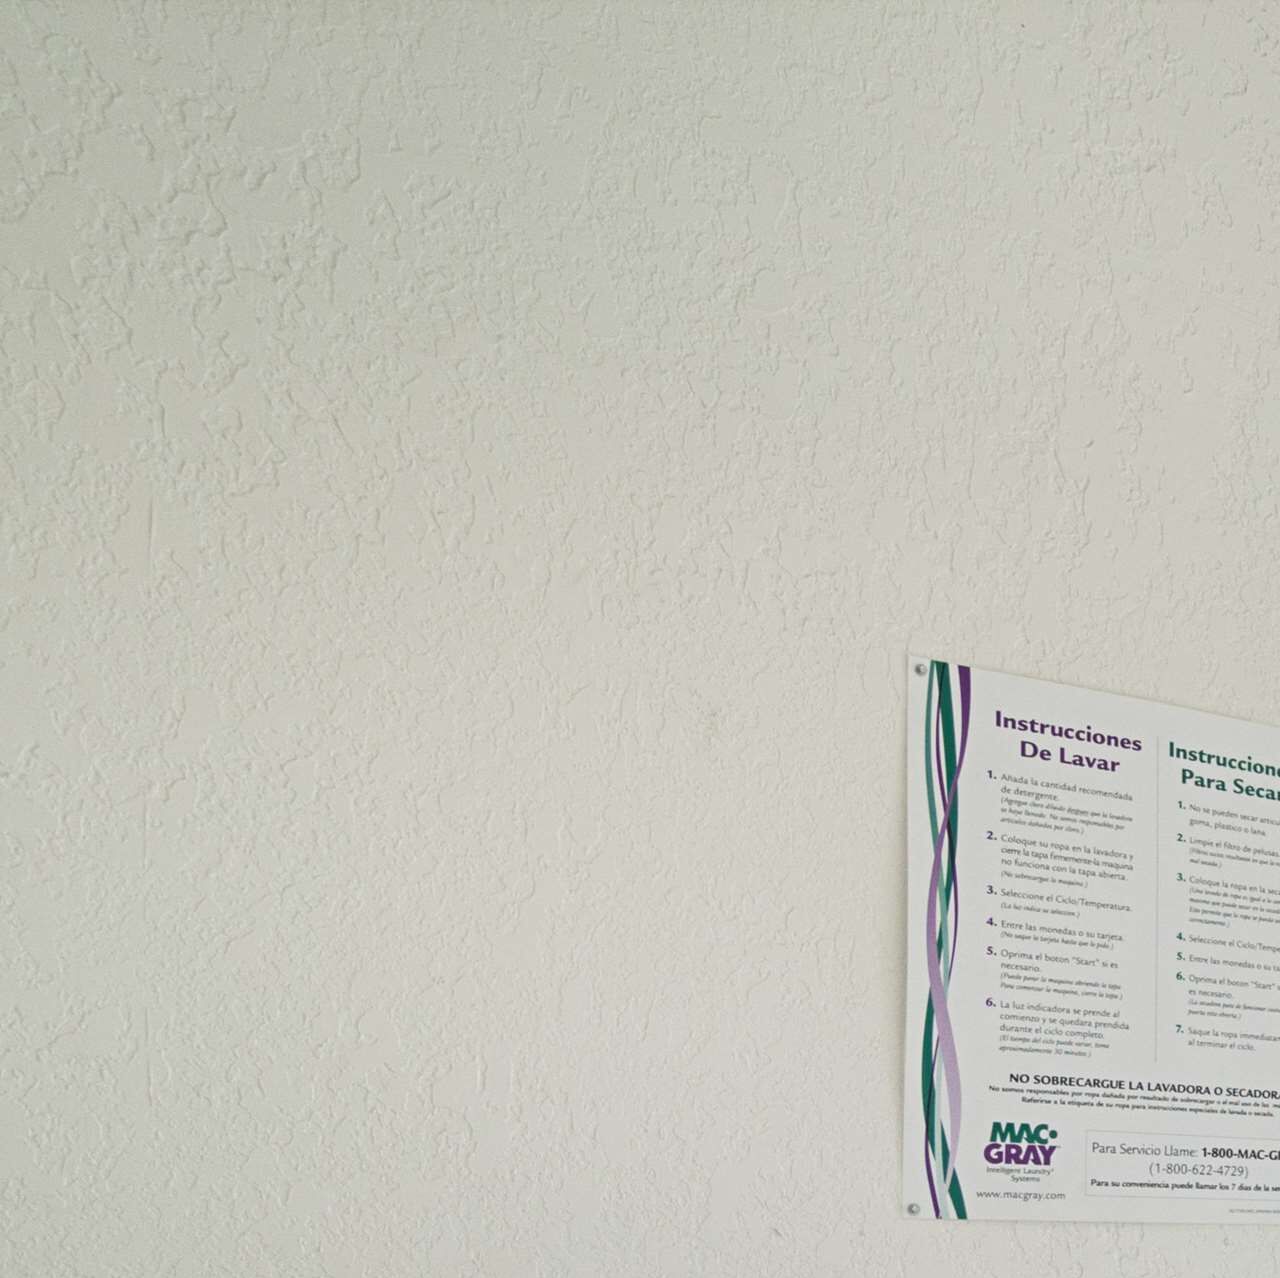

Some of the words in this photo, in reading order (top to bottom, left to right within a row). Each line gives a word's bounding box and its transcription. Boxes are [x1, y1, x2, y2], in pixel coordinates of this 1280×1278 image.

[995, 710, 1142, 751] Instrucciones
[1020, 741, 1051, 761] De
[1060, 747, 1120, 772] Lavar
[1031, 778, 1038, 786] la
[1040, 780, 1076, 792] cantidad
[1079, 787, 1133, 801] recomendada
[1182, 768, 1226, 792] Para
[986, 831, 997, 840] 2.
[1001, 834, 1036, 847] Coloque
[1051, 842, 1069, 851] ropa
[1084, 846, 1091, 854] la
[1094, 846, 1127, 860] lavadora
[1001, 858, 1012, 866] no
[1015, 858, 1049, 871] funciona
[1052, 865, 1067, 873] con
[1070, 866, 1076, 874] la
[1079, 869, 1095, 877] tapa
[986, 997, 996, 1007] 6.
[1001, 1000, 1009, 1009] La
[1013, 1000, 1024, 1010] luz
[1027, 1002, 1070, 1014] indicadora
[1083, 1008, 1110, 1019] prende
[1113, 1010, 1119, 1018] al
[1000, 1013, 1040, 1023] comienzo
[1049, 1016, 1057, 1024] se
[1095, 1020, 1129, 1031] prendida
[1009, 1073, 1029, 1083] NO
[1034, 1075, 1125, 1090] SOBRECARGUE
[1129, 1081, 1144, 1091] LA
[1147, 1082, 1210, 1095] LAVADORA
[1214, 1087, 1223, 1095] O
[984, 1143, 1056, 1166] GRAY
[1092, 1142, 1116, 1154] Para
[1120, 1143, 1161, 1156] Servicio
[1011, 1175, 1040, 1183] Systems
[1149, 1162, 1249, 1179] (1-800-622-4729)
[1091, 1179, 1109, 1187] Para
[1122, 1180, 1169, 1189] conveniencia
[1171, 1182, 1193, 1190] puede
[976, 1191, 1066, 1201] www.macgray.com
